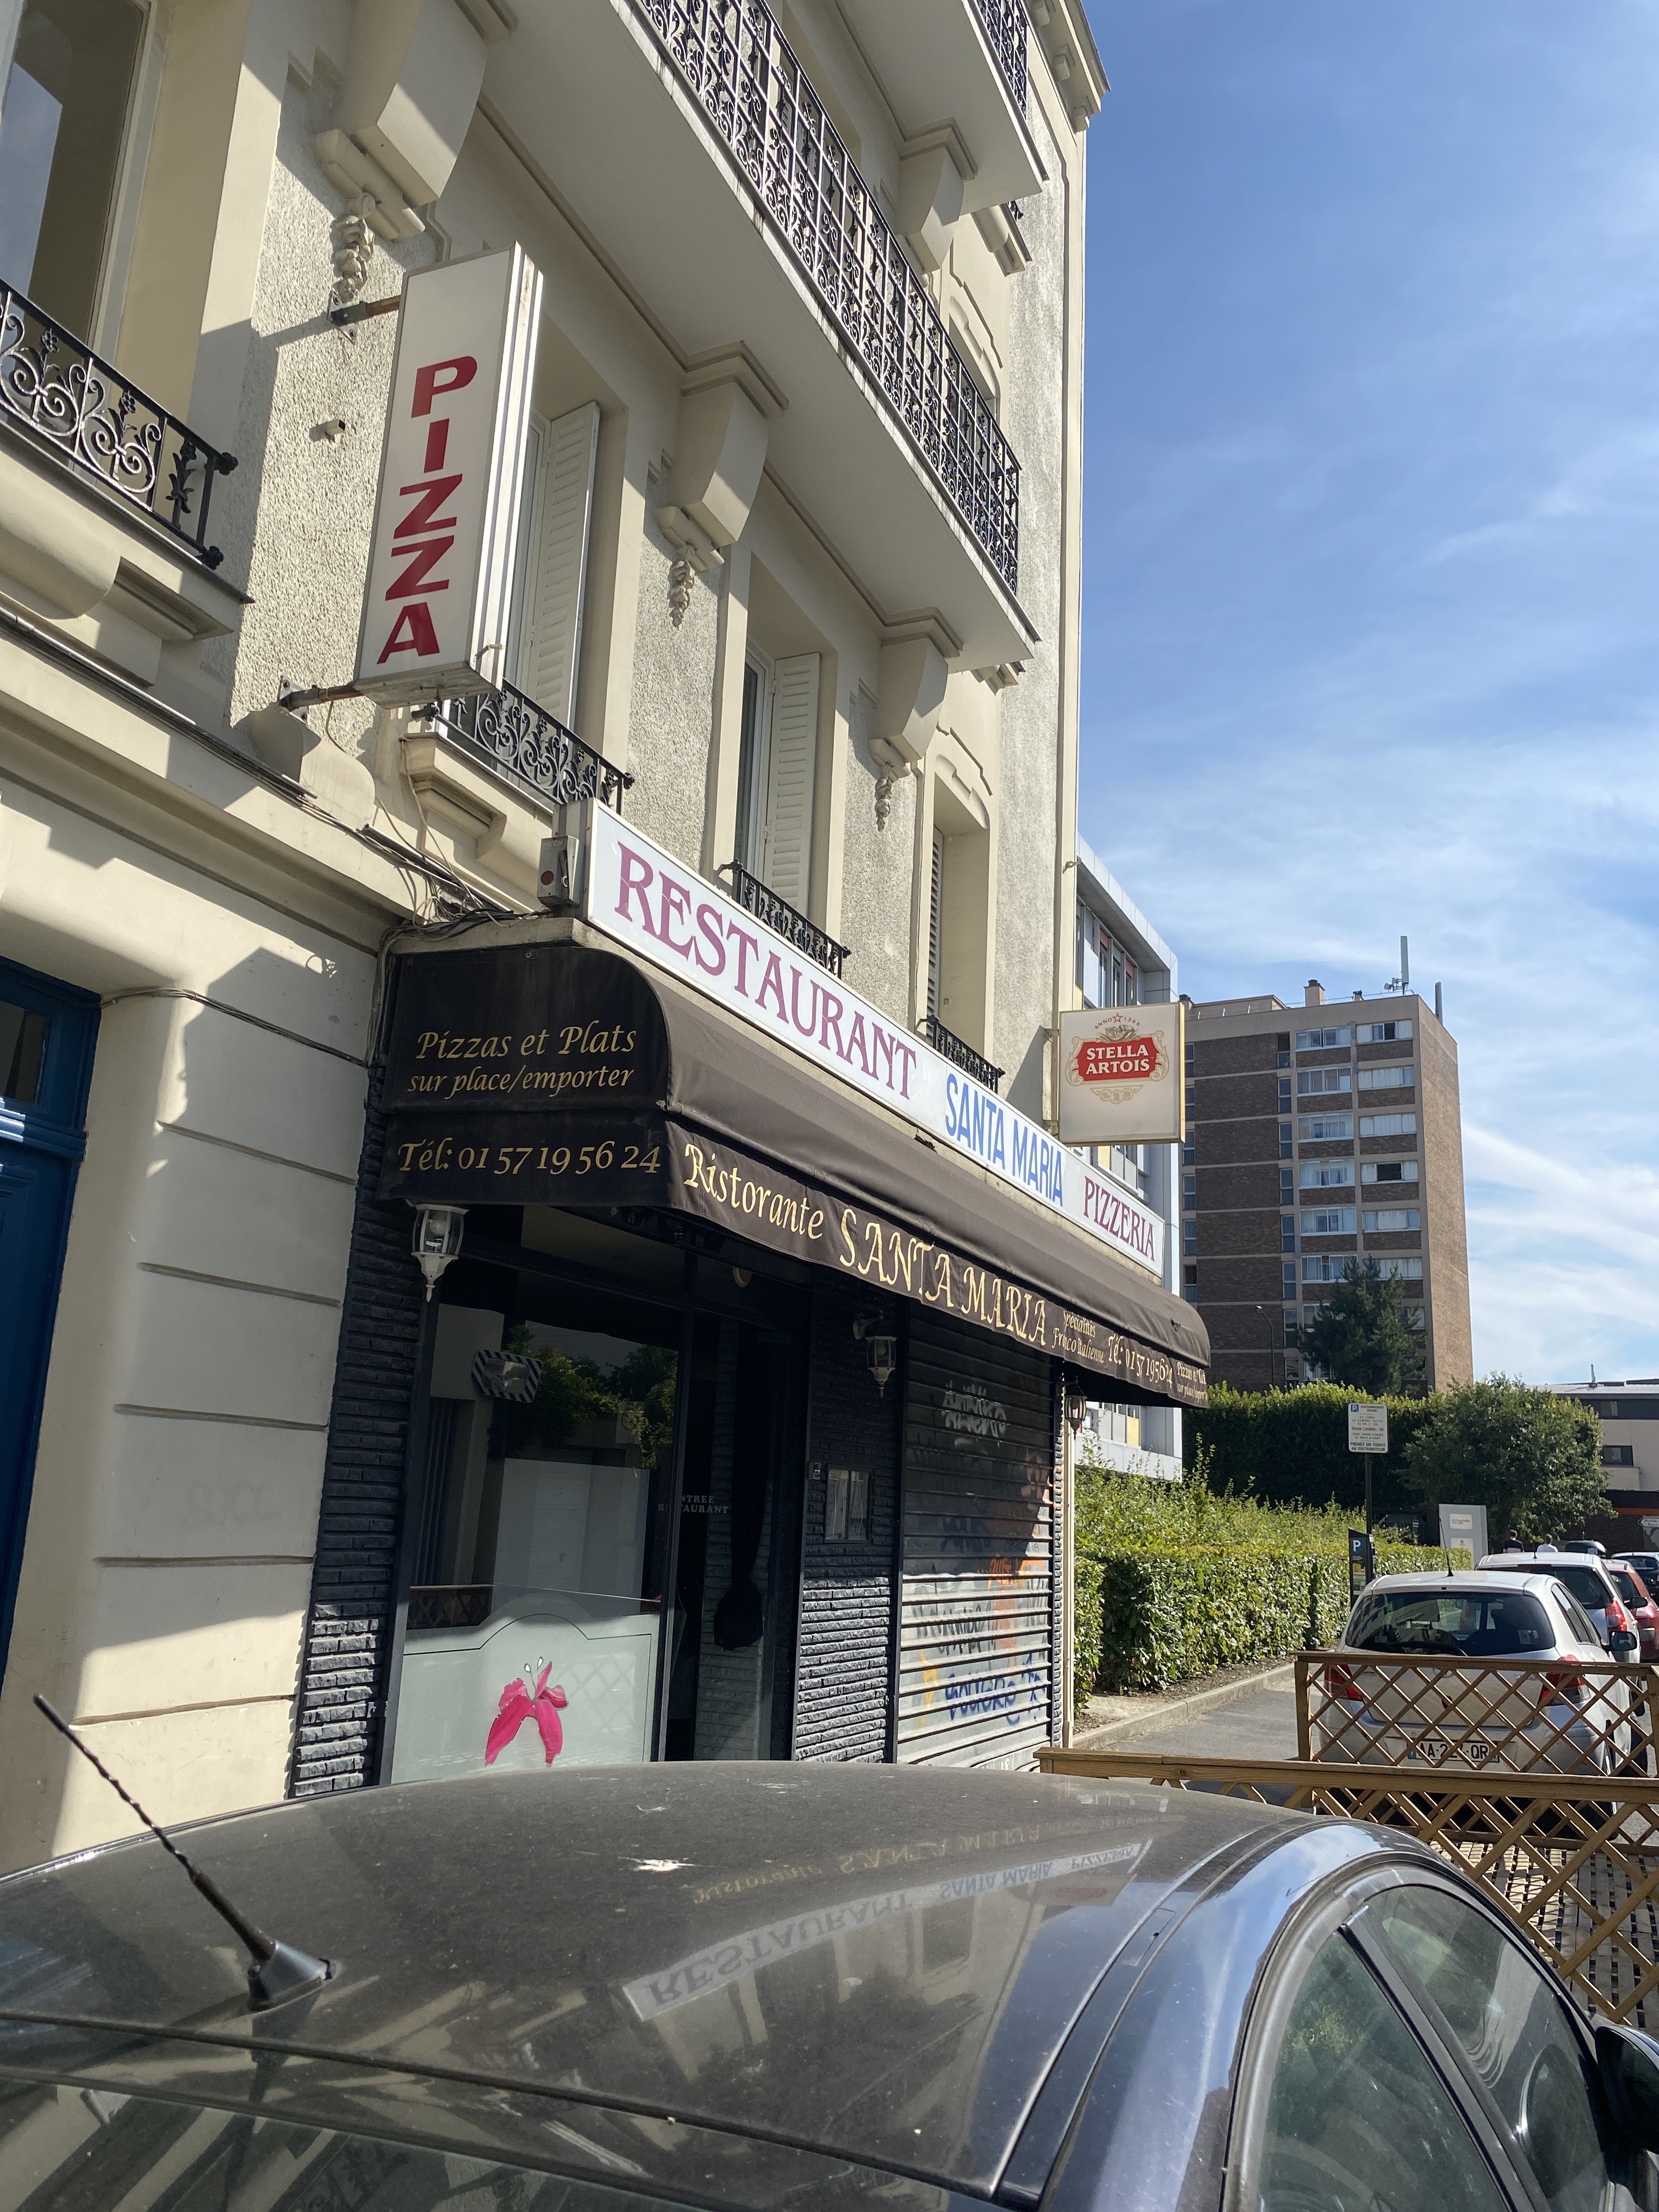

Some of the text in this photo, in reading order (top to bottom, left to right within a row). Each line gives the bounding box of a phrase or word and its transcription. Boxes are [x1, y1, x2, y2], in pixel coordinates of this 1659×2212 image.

[377, 356, 477, 664] PIZZA
[416, 1020, 636, 1059] Pizzas et Plats
[1094, 1017, 1112, 1029] ANNO
[615, 841, 1155, 1261] RESTAURANT SANTA MARIA PIZZERIA
[1086, 1044, 1149, 1060] STELLA
[1086, 1059, 1149, 1075] ARTOIS
[408, 1065, 635, 1099] sur place/emporter
[397, 1137, 453, 1171] Tél:
[620, 1146, 661, 1173] 24
[684, 1143, 1046, 1346] Ristorante SANTA MARIA
[681, 1494, 715, 1504] NTREE
